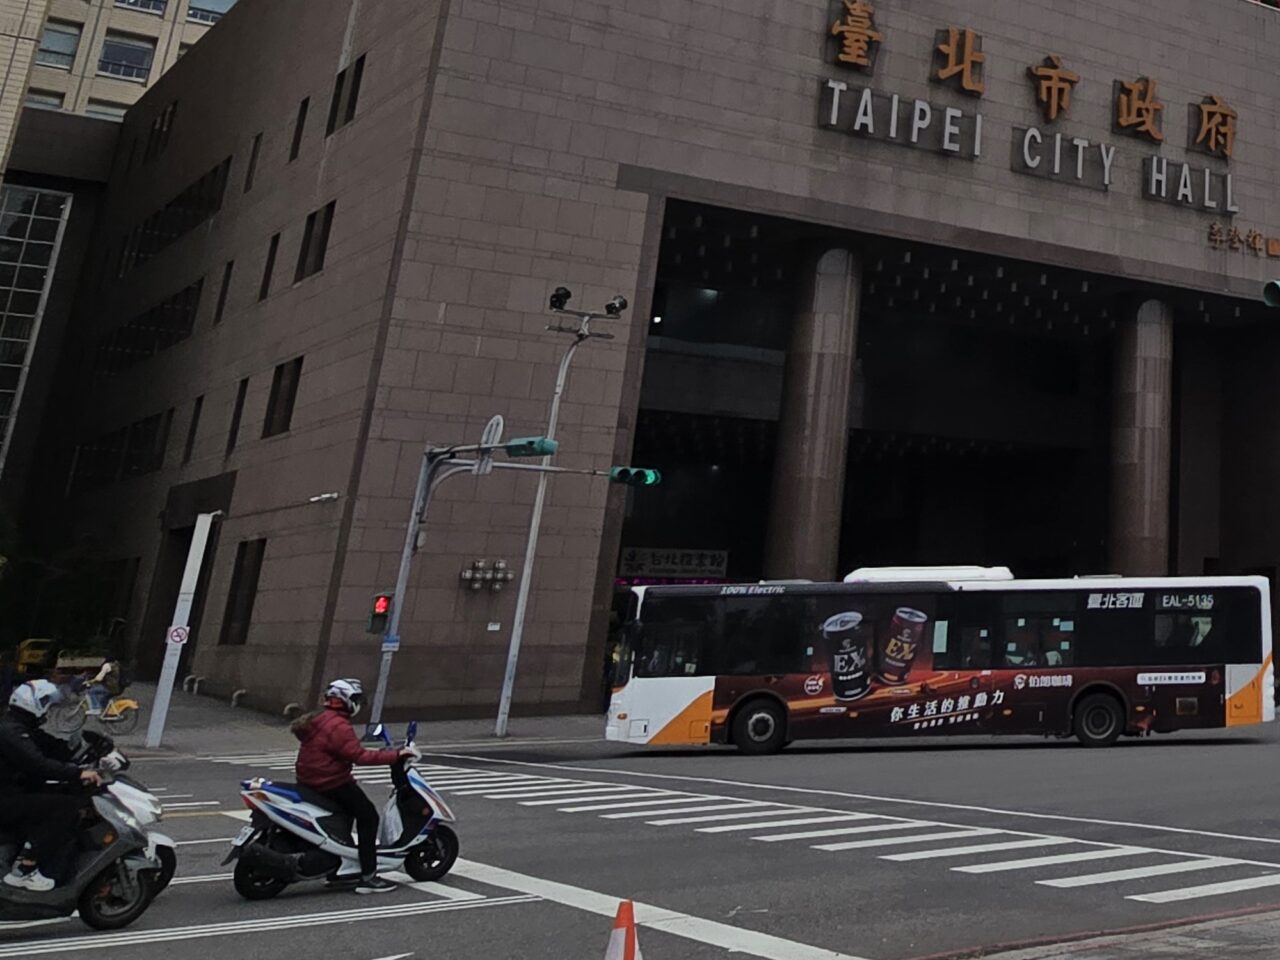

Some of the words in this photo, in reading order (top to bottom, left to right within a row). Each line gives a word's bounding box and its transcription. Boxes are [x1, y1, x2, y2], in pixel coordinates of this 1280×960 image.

[826, 80, 984, 156] TAIPEI
[1022, 126, 1116, 186] CITY
[1149, 154, 1240, 214] HALL
[1162, 594, 1214, 608] EAL-5135
[833, 648, 866, 673] EX
[889, 690, 1005, 723] 你生活的推動力
